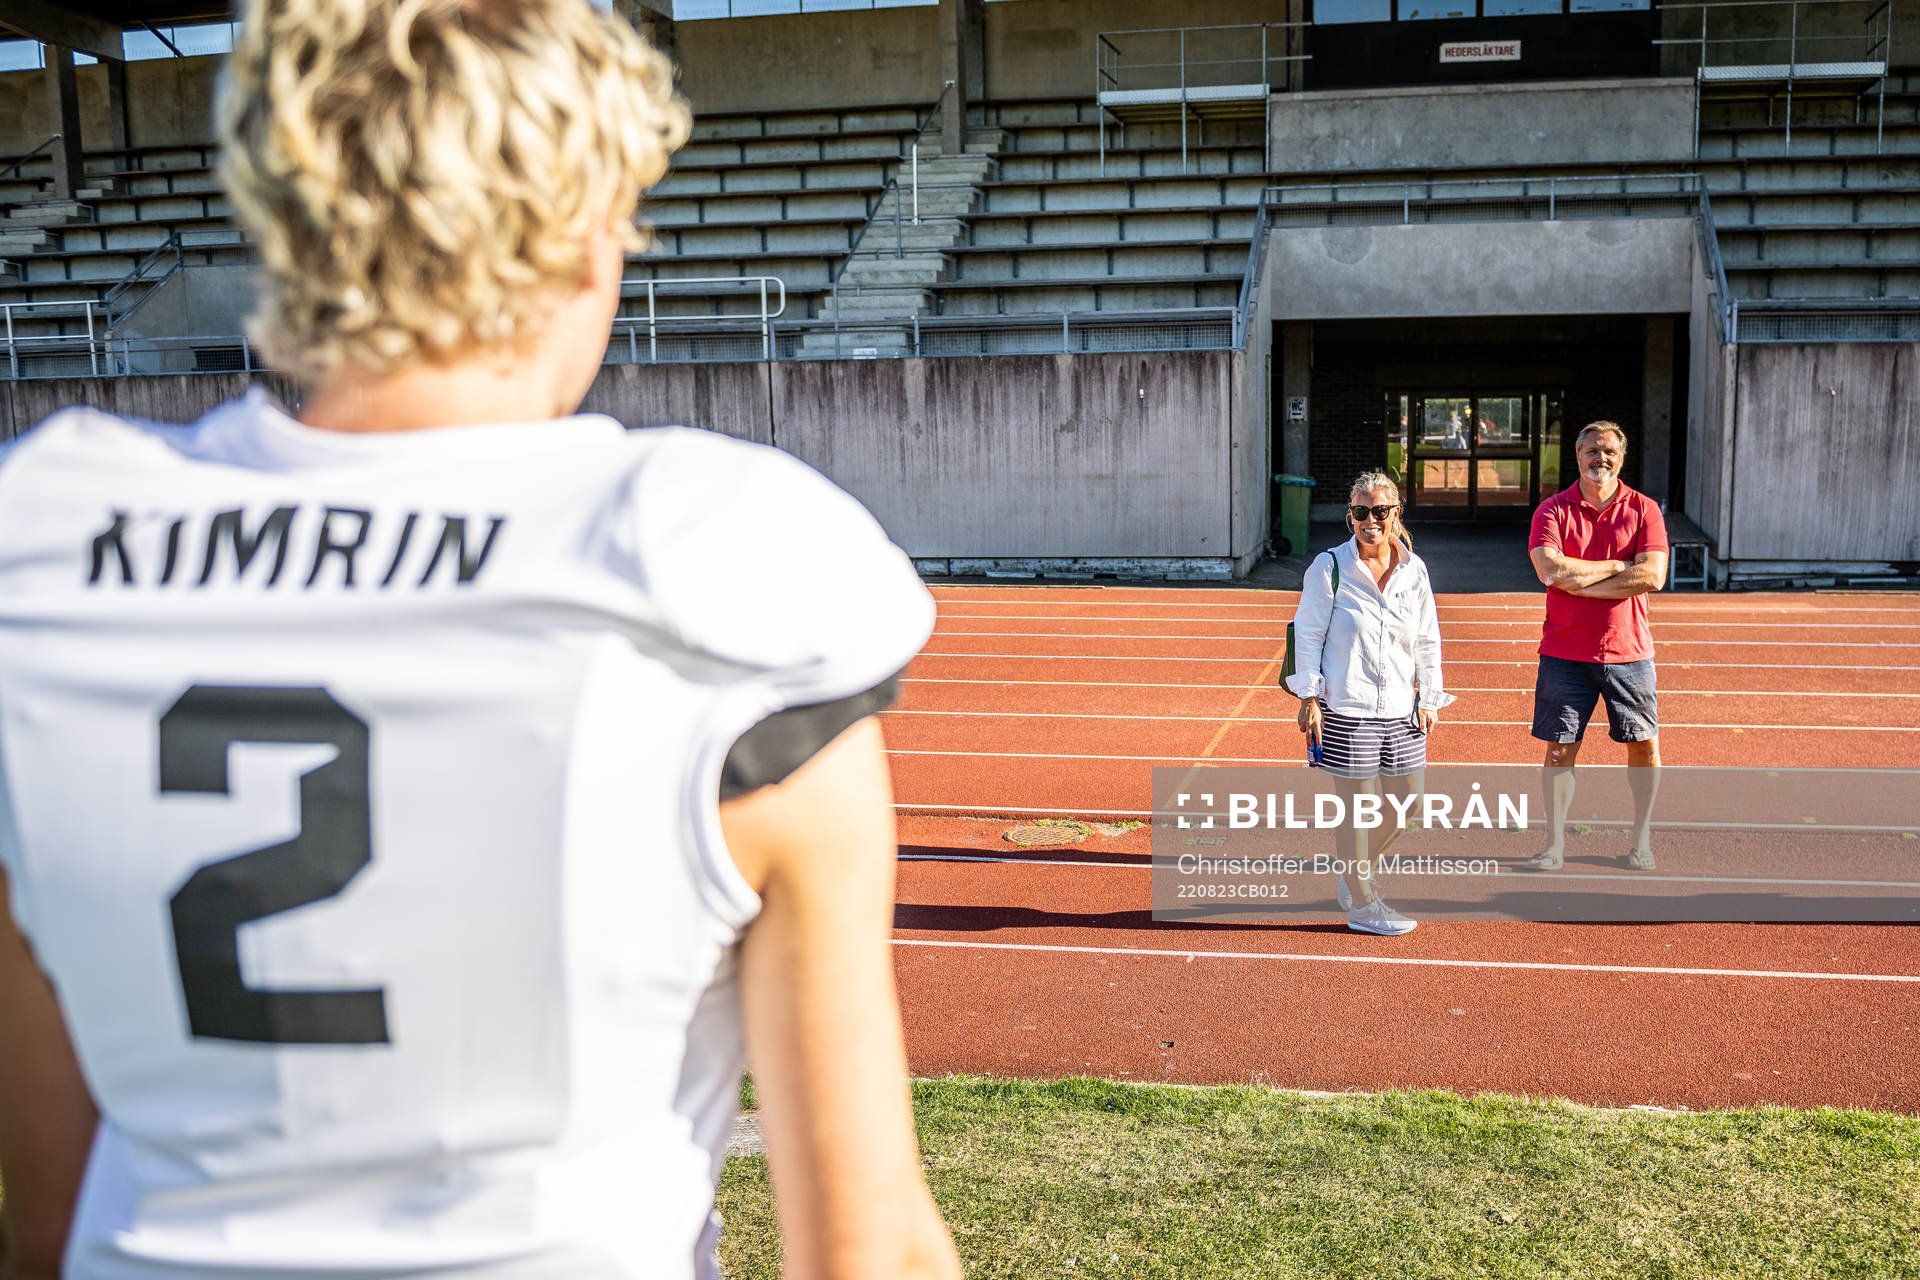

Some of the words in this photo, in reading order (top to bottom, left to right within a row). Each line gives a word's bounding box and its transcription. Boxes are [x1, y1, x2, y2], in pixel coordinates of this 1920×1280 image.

[1444, 44, 1516, 57] HEDERSLÄKTARE
[1291, 401, 1303, 412] WC
[88, 503, 506, 588] KIMRIN
[159, 684, 392, 1046] 2
